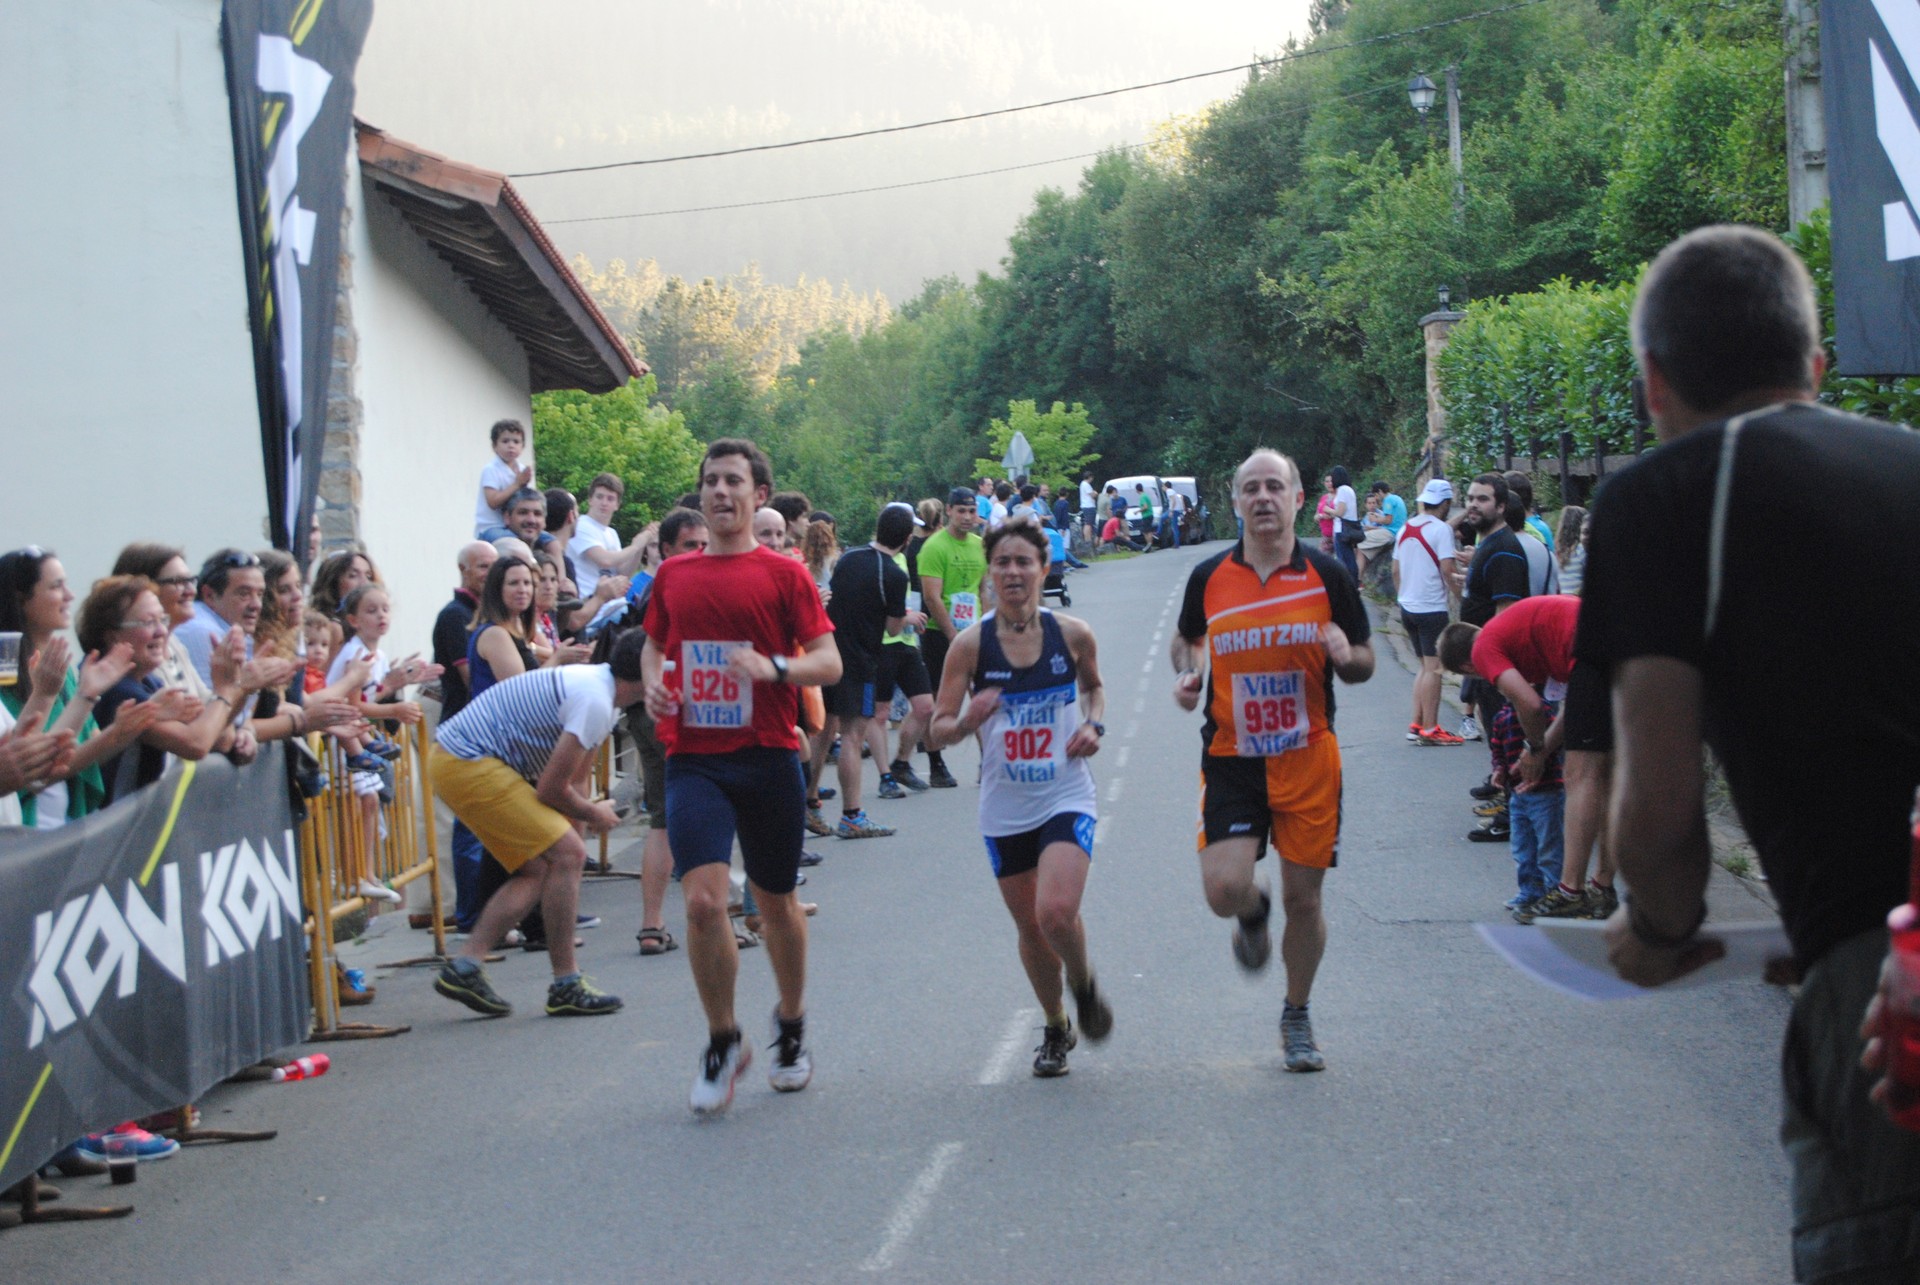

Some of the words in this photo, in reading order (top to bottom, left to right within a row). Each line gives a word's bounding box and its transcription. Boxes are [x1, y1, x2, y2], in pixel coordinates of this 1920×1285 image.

[954, 603, 974, 619] 924
[692, 669, 739, 702] 926
[1244, 672, 1298, 696] Vital
[691, 703, 742, 725] Vital
[1006, 704, 1055, 727] Vital
[1245, 697, 1297, 733] 936
[1004, 728, 1053, 762] 902
[1005, 762, 1055, 783] Vital
